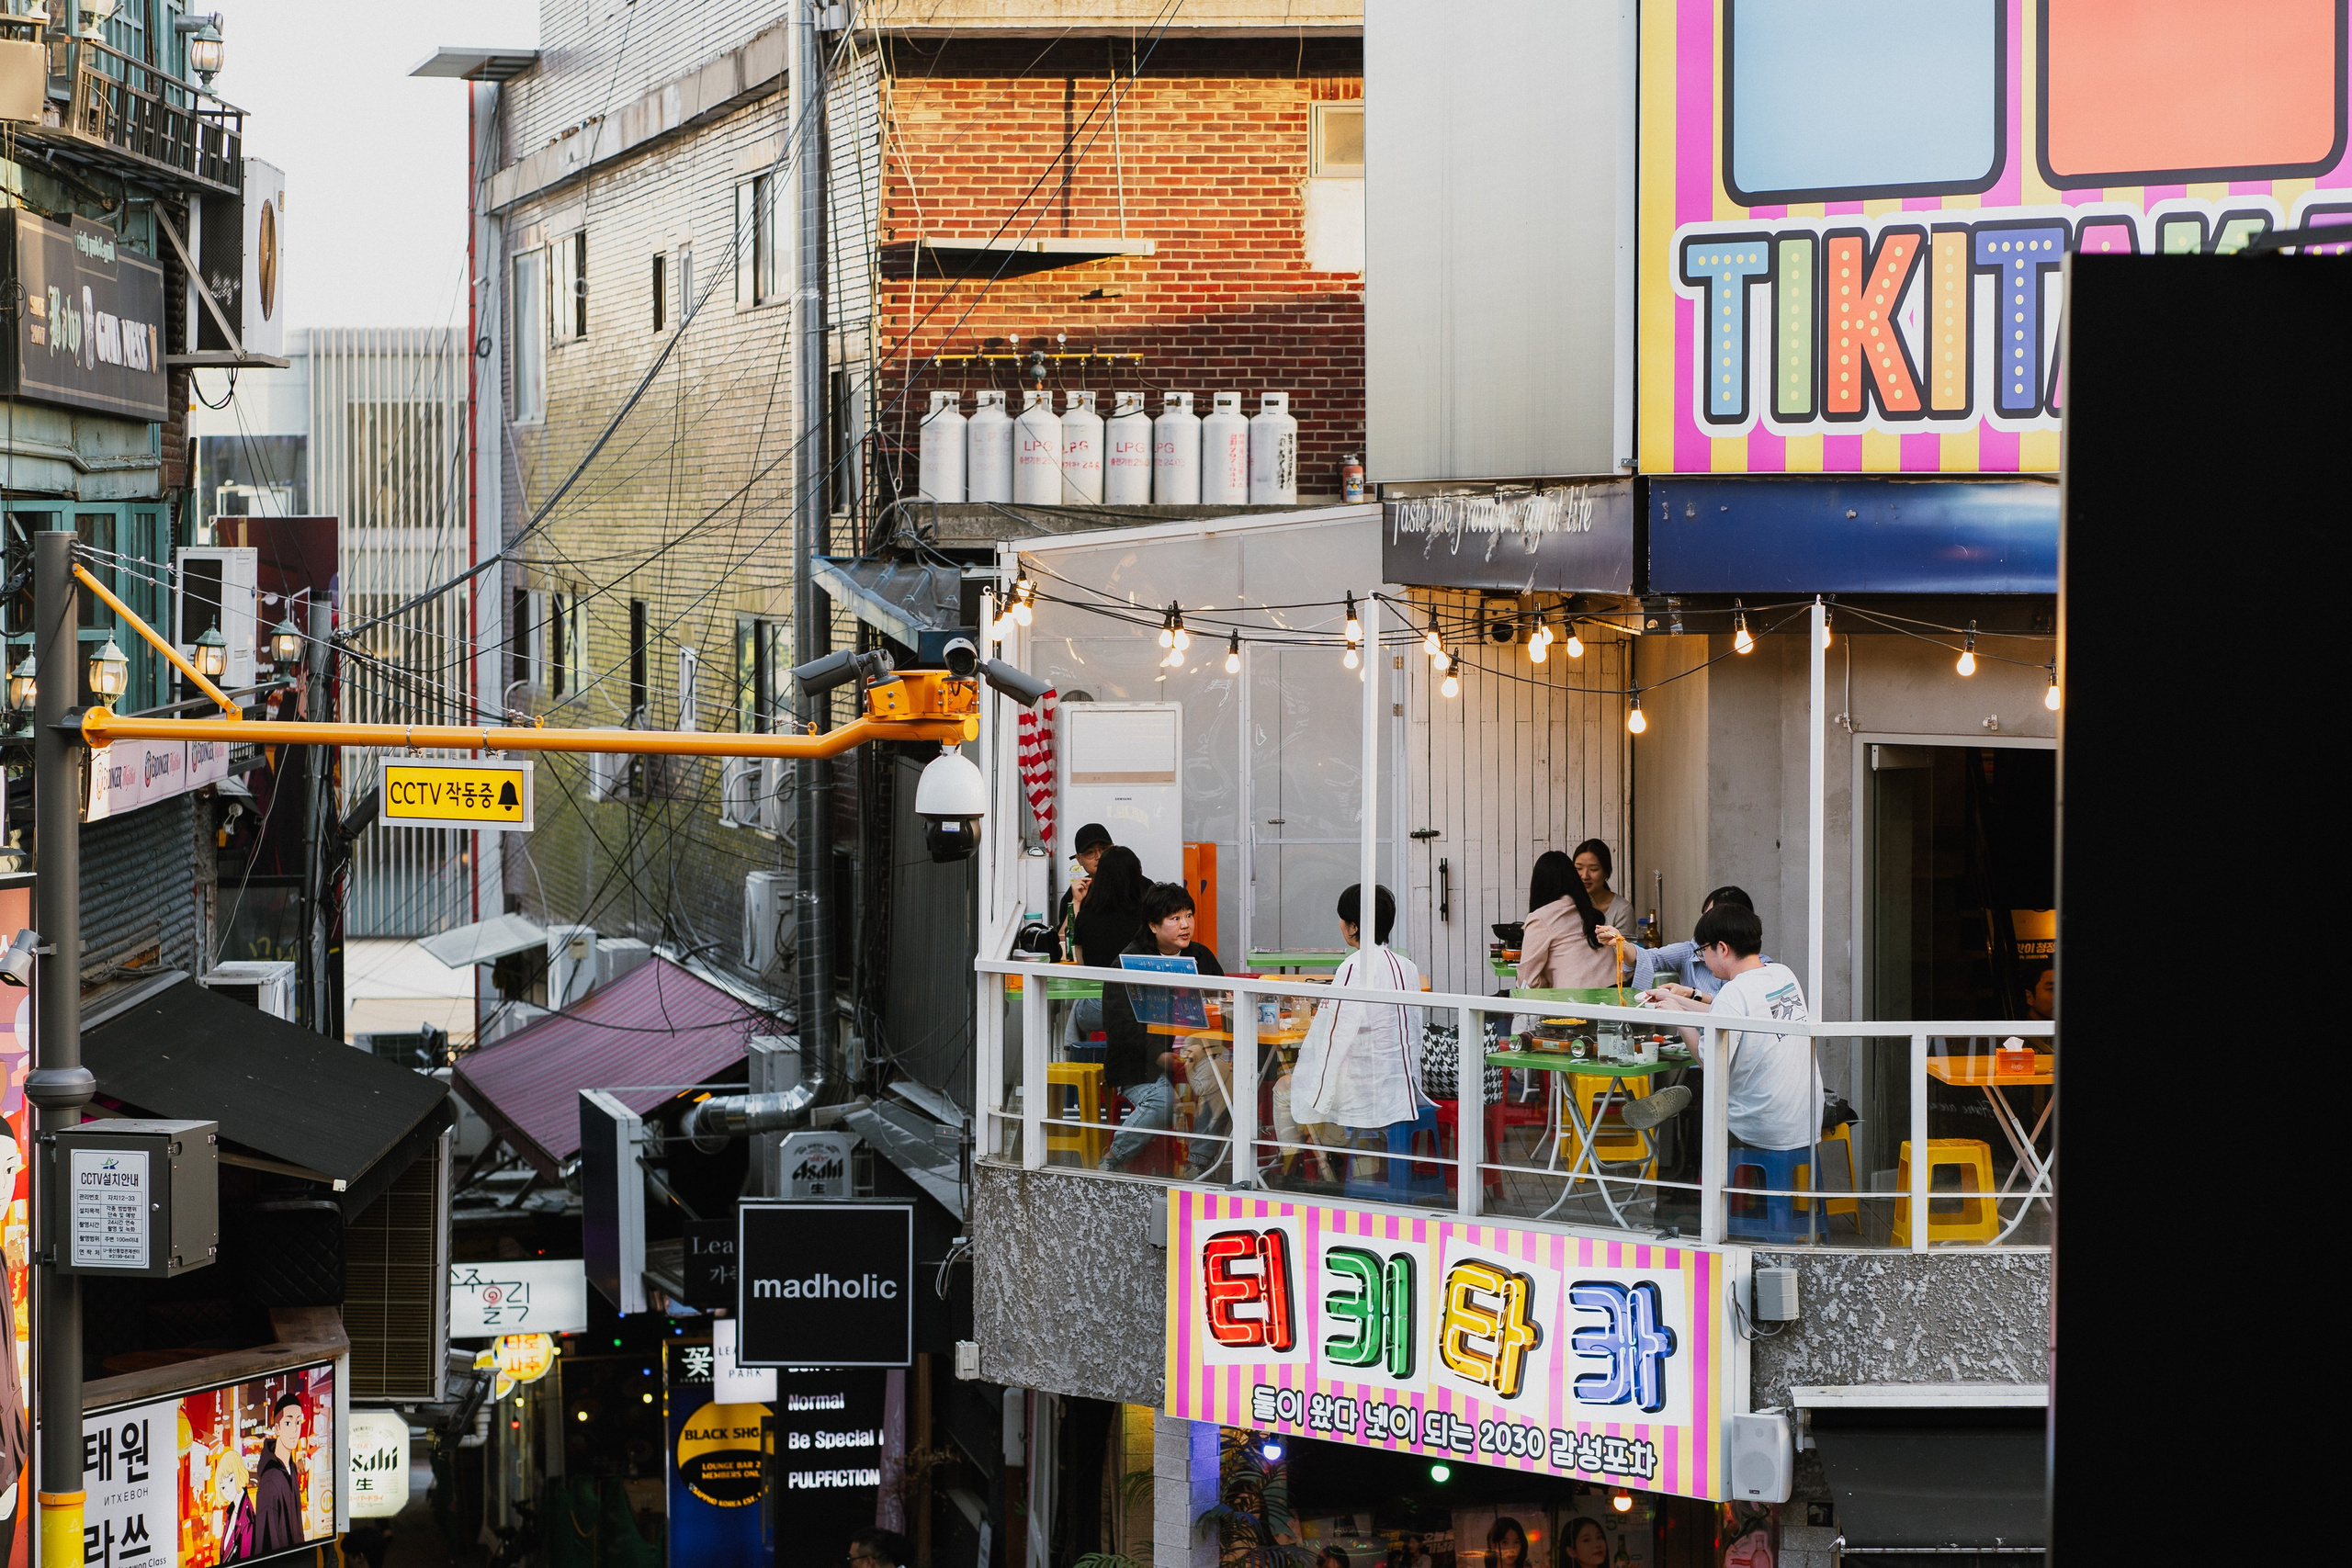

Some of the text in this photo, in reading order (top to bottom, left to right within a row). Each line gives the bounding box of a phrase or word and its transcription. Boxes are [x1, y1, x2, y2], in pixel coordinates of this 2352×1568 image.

[1024, 440, 1054, 452] LPG
[1115, 442, 1146, 453] LPG
[152, 752, 169, 780] ERDINGER
[390, 781, 494, 808] CCTV 작동중
[792, 1158, 843, 1180] Asahi
[81, 1172, 139, 1187] CCTV설치안내
[810, 1182, 825, 1194] 生
[753, 1273, 898, 1299] madholic
[1200, 1227, 1678, 1415] 티키타카
[682, 1347, 715, 1378] 꽃
[788, 1392, 844, 1411] Normal
[684, 1428, 729, 1440] BLACK
[788, 1432, 810, 1450] Be
[815, 1429, 875, 1450] Special
[1252, 1383, 1657, 1481] 둘이 왔다 넷이 되는 2030 감성포차
[349, 1446, 398, 1473] sahi
[702, 1462, 733, 1471] LOUNGE
[736, 1461, 750, 1470] BAR
[356, 1477, 373, 1491] 生
[702, 1471, 741, 1480] MEMBERS
[788, 1469, 881, 1489] PULPFICTION
[148, 1557, 167, 1568] Class
